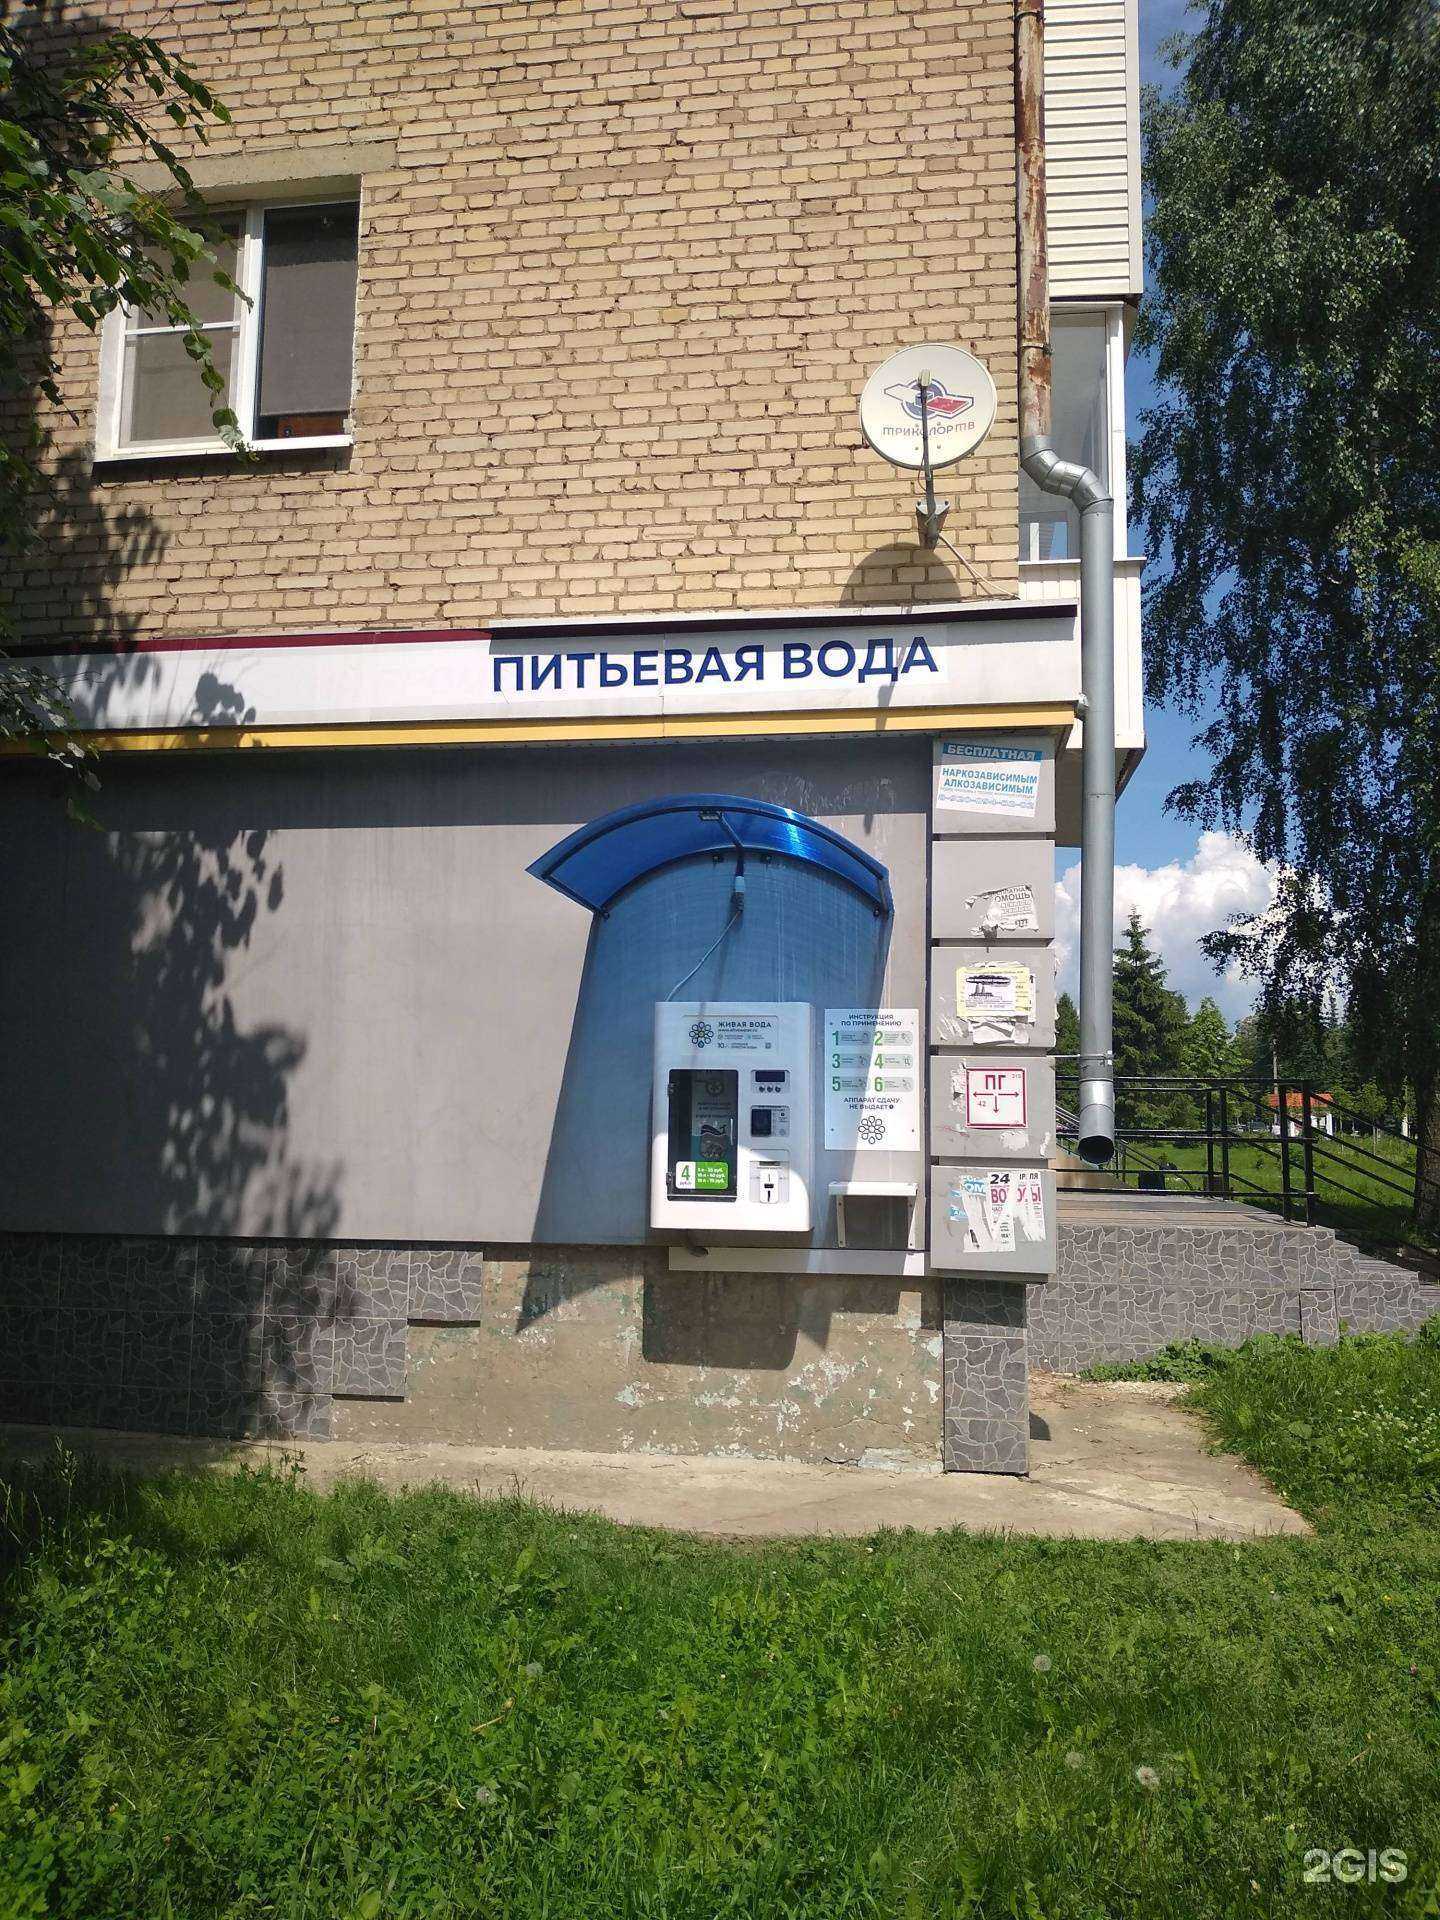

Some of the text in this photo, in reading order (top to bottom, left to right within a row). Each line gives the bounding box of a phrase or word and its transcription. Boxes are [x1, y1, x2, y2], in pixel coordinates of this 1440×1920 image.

[493, 636, 938, 692] ПИТЬЕВАЯ ВОДА
[947, 744, 1036, 760] БЕСПЛАТНАЯ
[942, 767, 1038, 784] НАРКОЗАВИСИМЫМ
[943, 778, 1033, 795] АЛКОЗАВИСИМЫМ
[832, 1030, 839, 1046] 1
[874, 1030, 883, 1046] 2
[832, 1053, 840, 1068] 3
[874, 1053, 884, 1069] 4
[832, 1076, 840, 1091] 5
[874, 1076, 883, 1092] 6
[985, 1074, 1006, 1090] ПГ
[681, 1165, 691, 1181] 4
[990, 1173, 1011, 1185] 24
